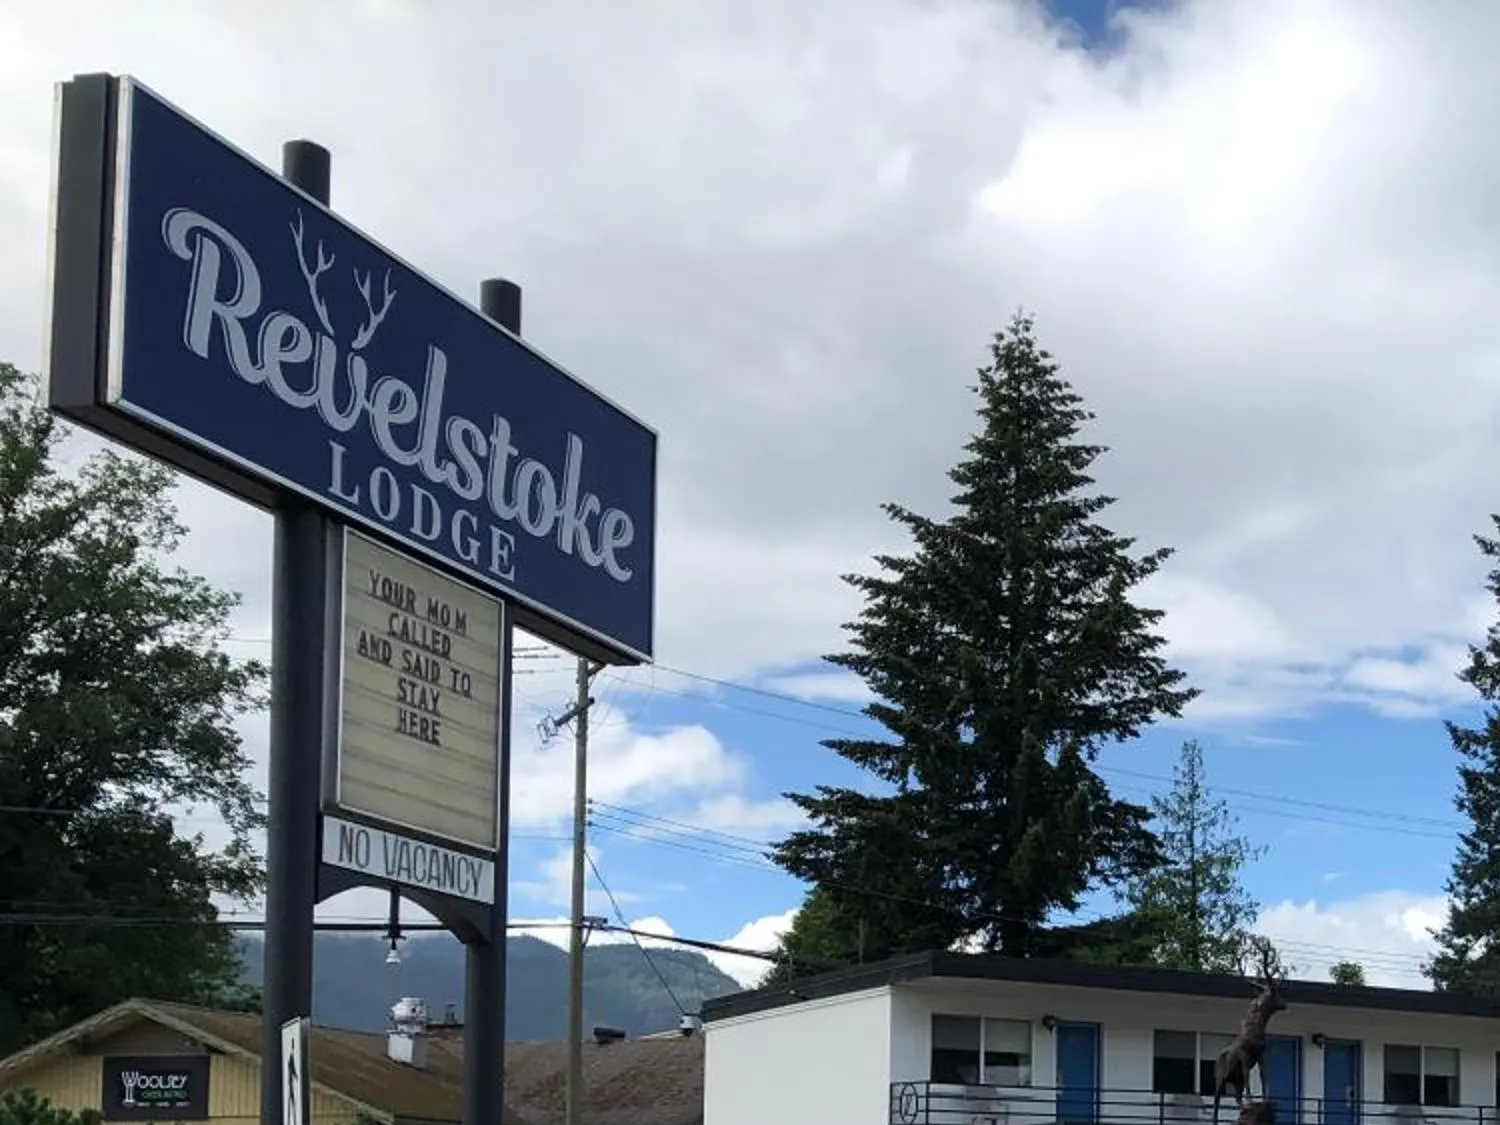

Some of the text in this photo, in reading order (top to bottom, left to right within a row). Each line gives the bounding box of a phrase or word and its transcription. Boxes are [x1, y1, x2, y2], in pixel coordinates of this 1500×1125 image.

[161, 207, 635, 582] Revelstoke
[327, 440, 516, 582] LODGE
[368, 569, 468, 637] YOUR MOM
[387, 612, 451, 660] CALLED
[357, 630, 473, 700] AND SAID TO
[398, 677, 441, 717] STAY
[396, 707, 441, 746] HERE
[338, 824, 483, 897] NO VACANCY
